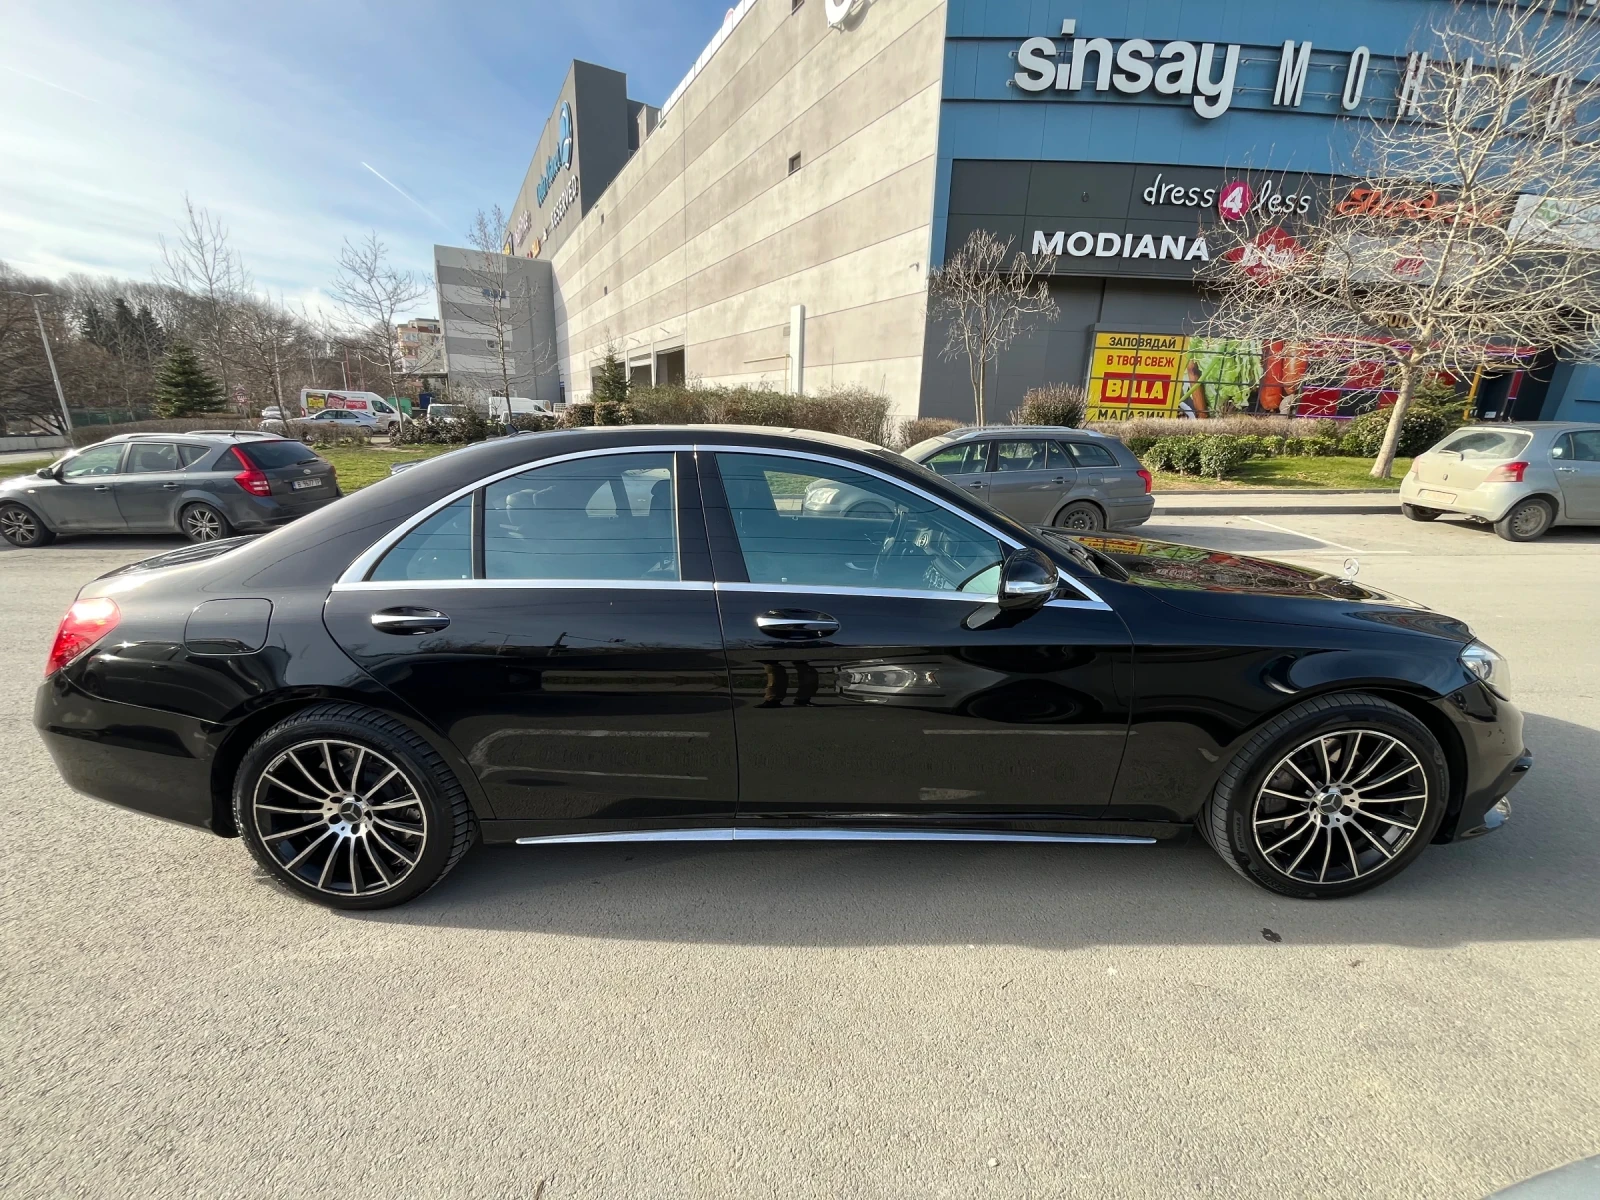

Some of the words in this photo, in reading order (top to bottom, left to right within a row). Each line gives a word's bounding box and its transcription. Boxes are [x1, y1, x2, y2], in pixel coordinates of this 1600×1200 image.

[1014, 19, 1241, 119] sinsay
[1143, 173, 1215, 208] dress
[1222, 186, 1244, 213] 4
[1252, 179, 1312, 215] less
[1031, 230, 1210, 261] MODIANA
[1108, 336, 1177, 350] ЗАПОВЯДАЙ
[1106, 354, 1114, 365] В
[1116, 355, 1143, 366] ТВОЯ
[1144, 356, 1175, 368] СВЕЖ
[1105, 378, 1164, 400] BILLA
